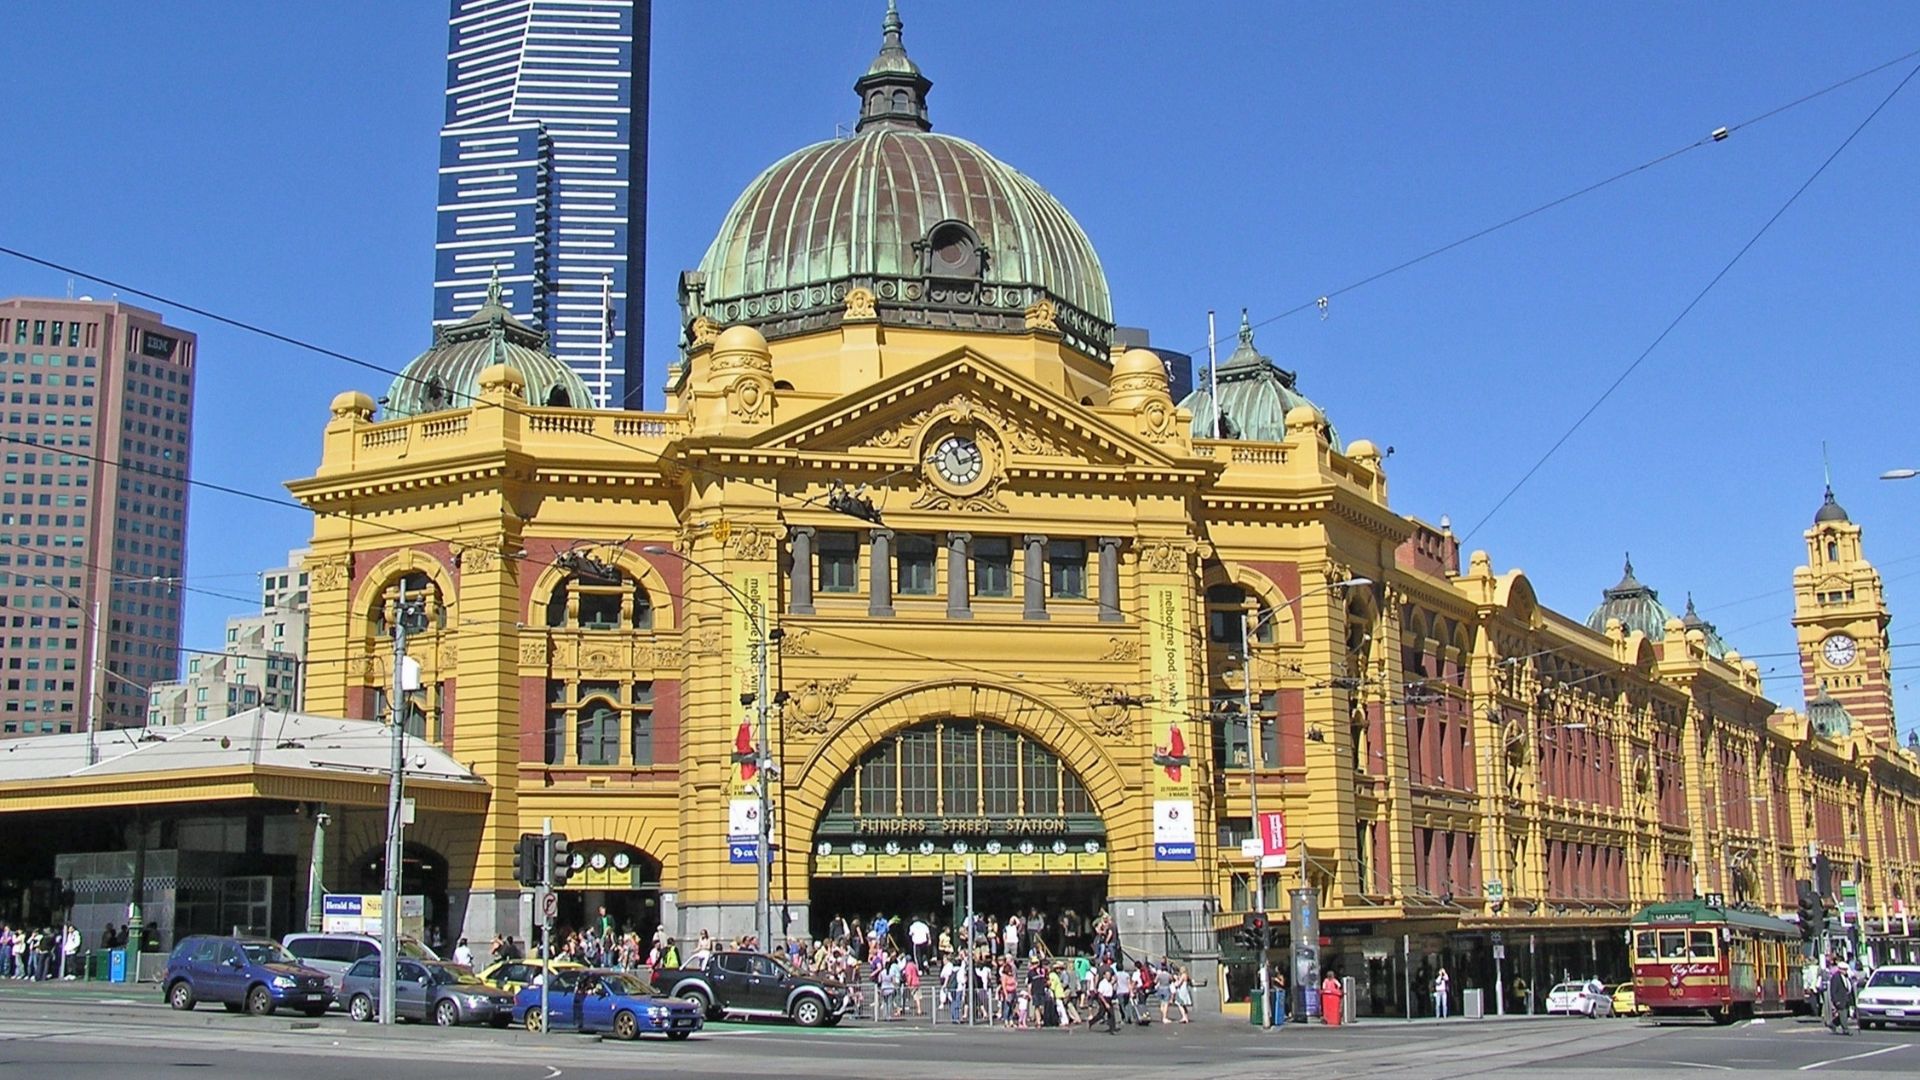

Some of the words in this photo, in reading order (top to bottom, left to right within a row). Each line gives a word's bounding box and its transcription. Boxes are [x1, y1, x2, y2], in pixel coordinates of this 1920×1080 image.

[147, 336, 168, 352] IBM
[750, 578, 760, 636] melbourne
[1165, 590, 1175, 646] melbourne
[748, 638, 760, 664] food
[1165, 647, 1177, 672] food
[860, 818, 926, 831] FLINDERS
[942, 818, 991, 831] STREET
[1006, 818, 1064, 831] STATION
[1168, 847, 1192, 855] connex
[326, 900, 347, 910] Herald
[349, 901, 361, 910] Sun
[1708, 895, 1722, 906] 35
[1077, 960, 1082, 969] 7
[1670, 964, 1688, 977] City
